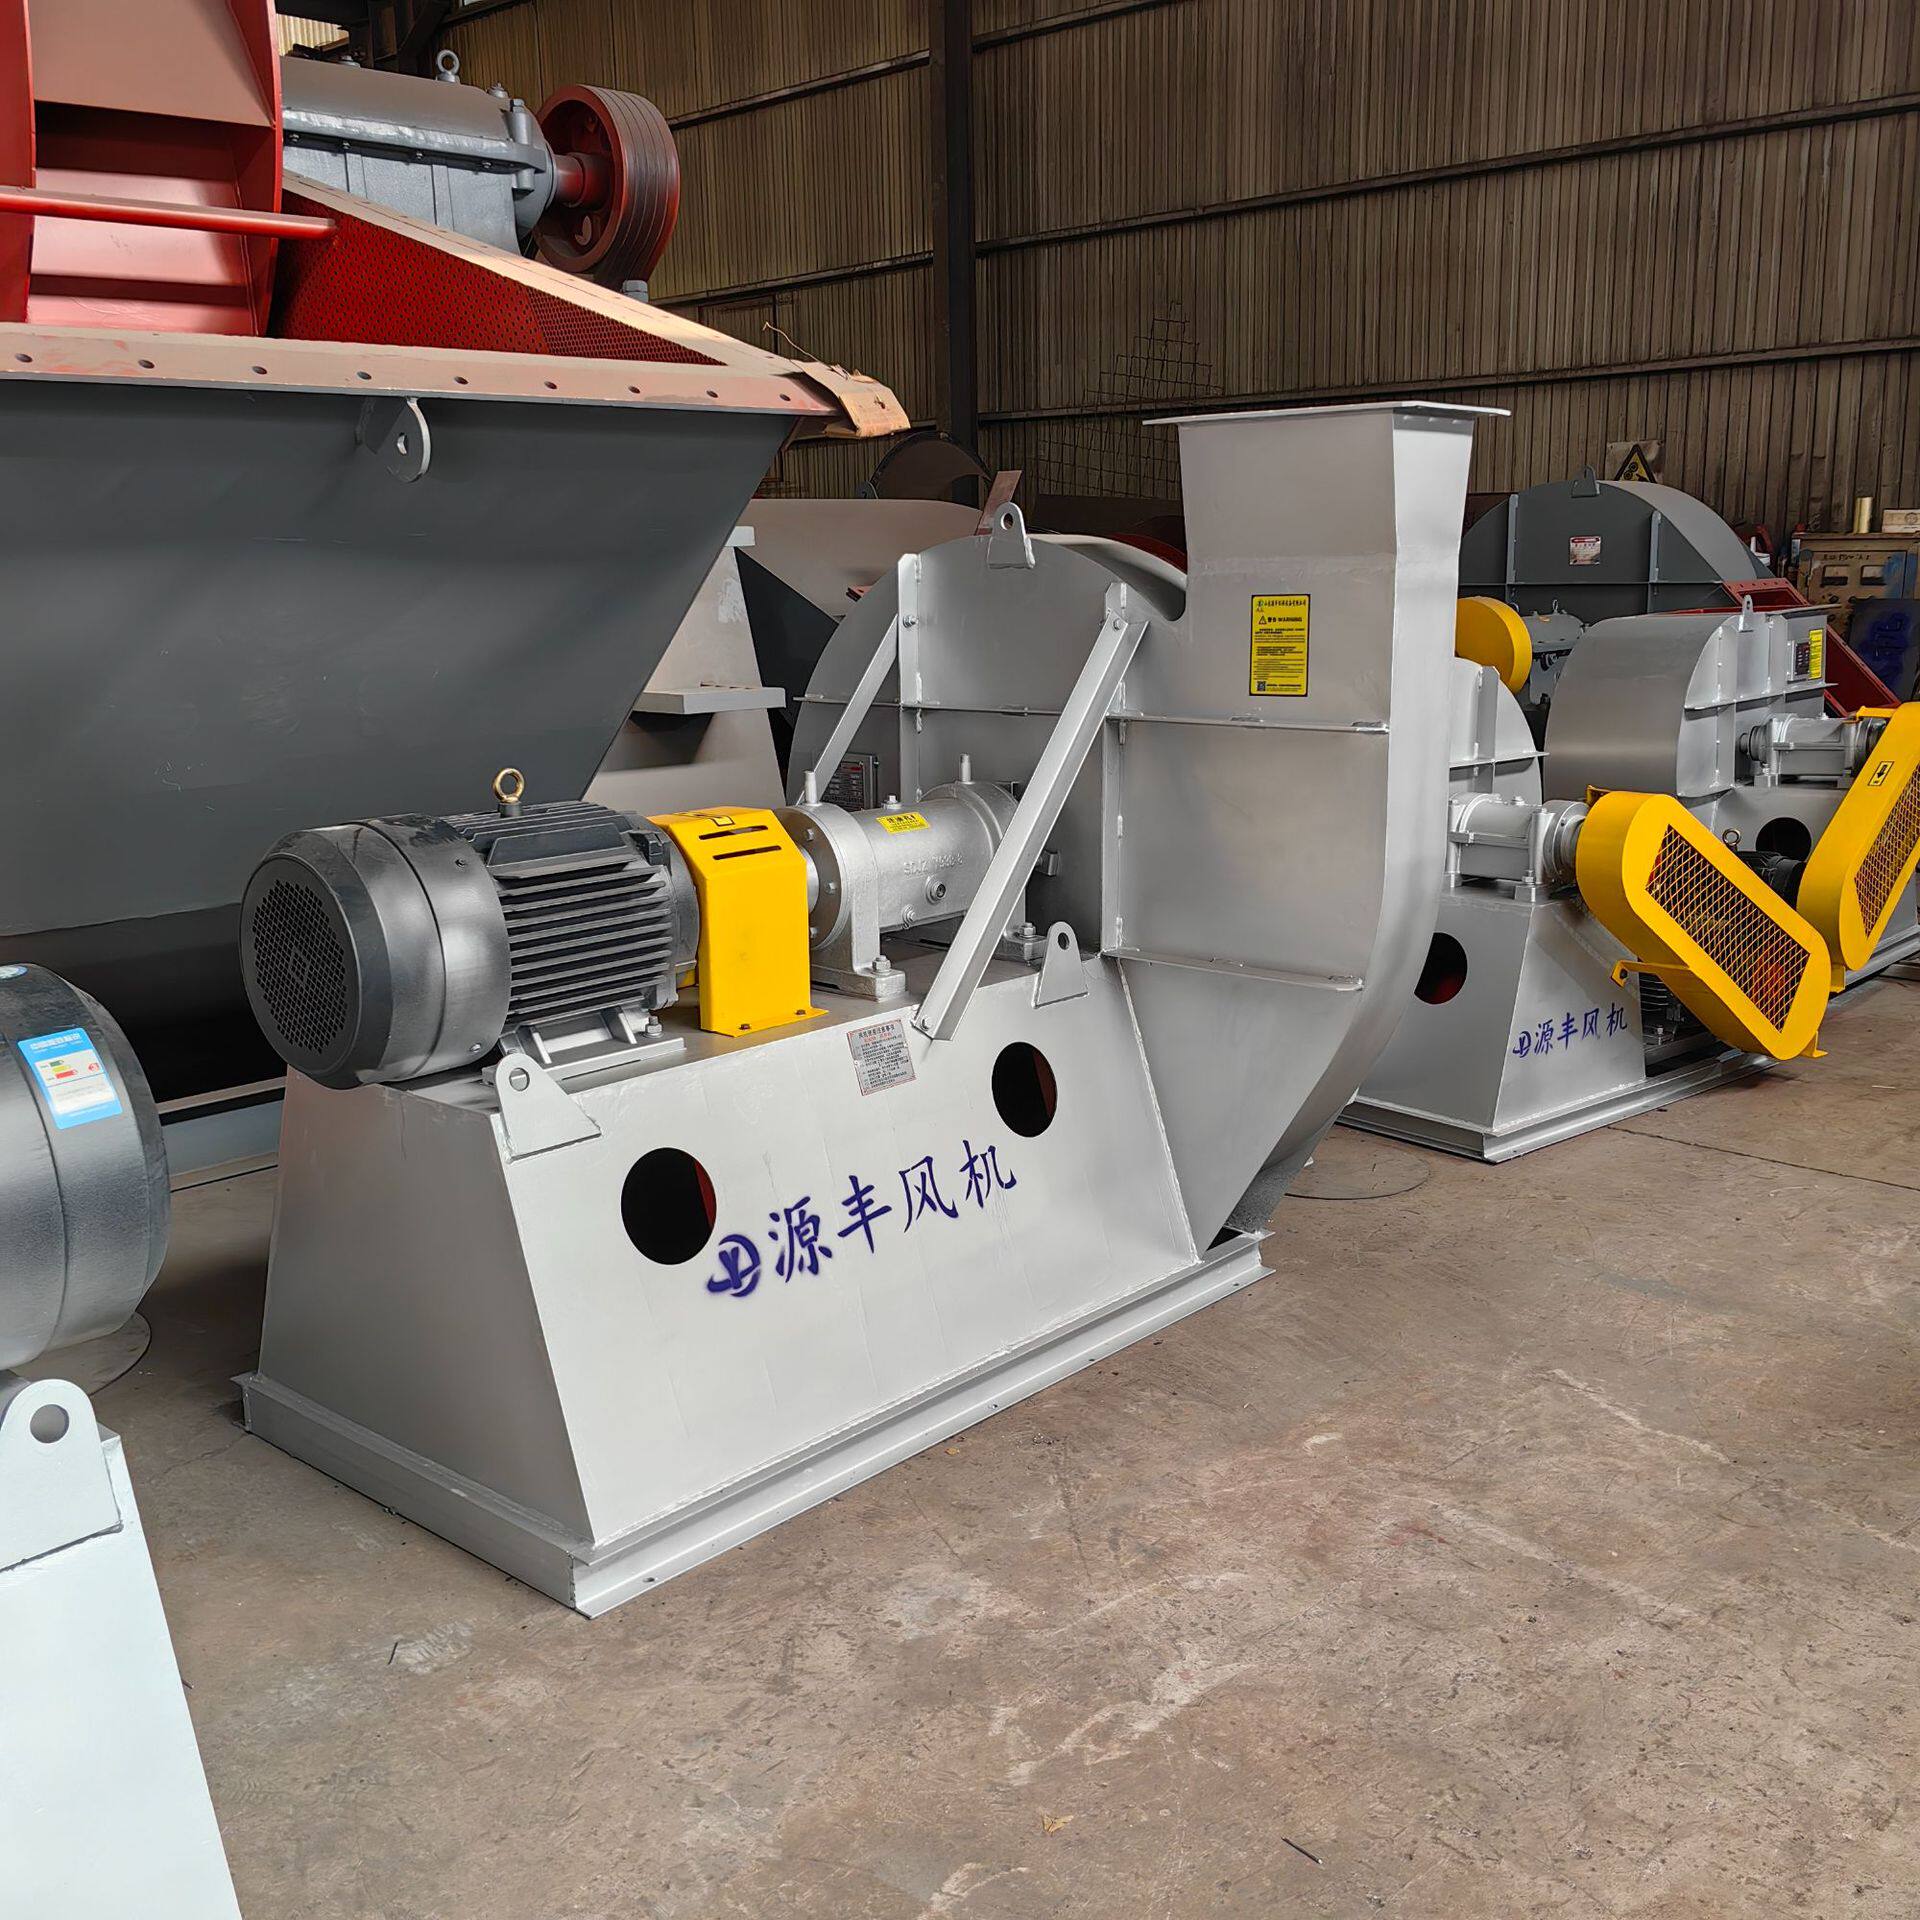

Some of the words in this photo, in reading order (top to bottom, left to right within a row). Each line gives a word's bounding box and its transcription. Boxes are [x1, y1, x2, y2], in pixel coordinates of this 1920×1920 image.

[1533, 1002, 1628, 1056] 源丰风机
[767, 1139, 1018, 1284] 源丰风机
